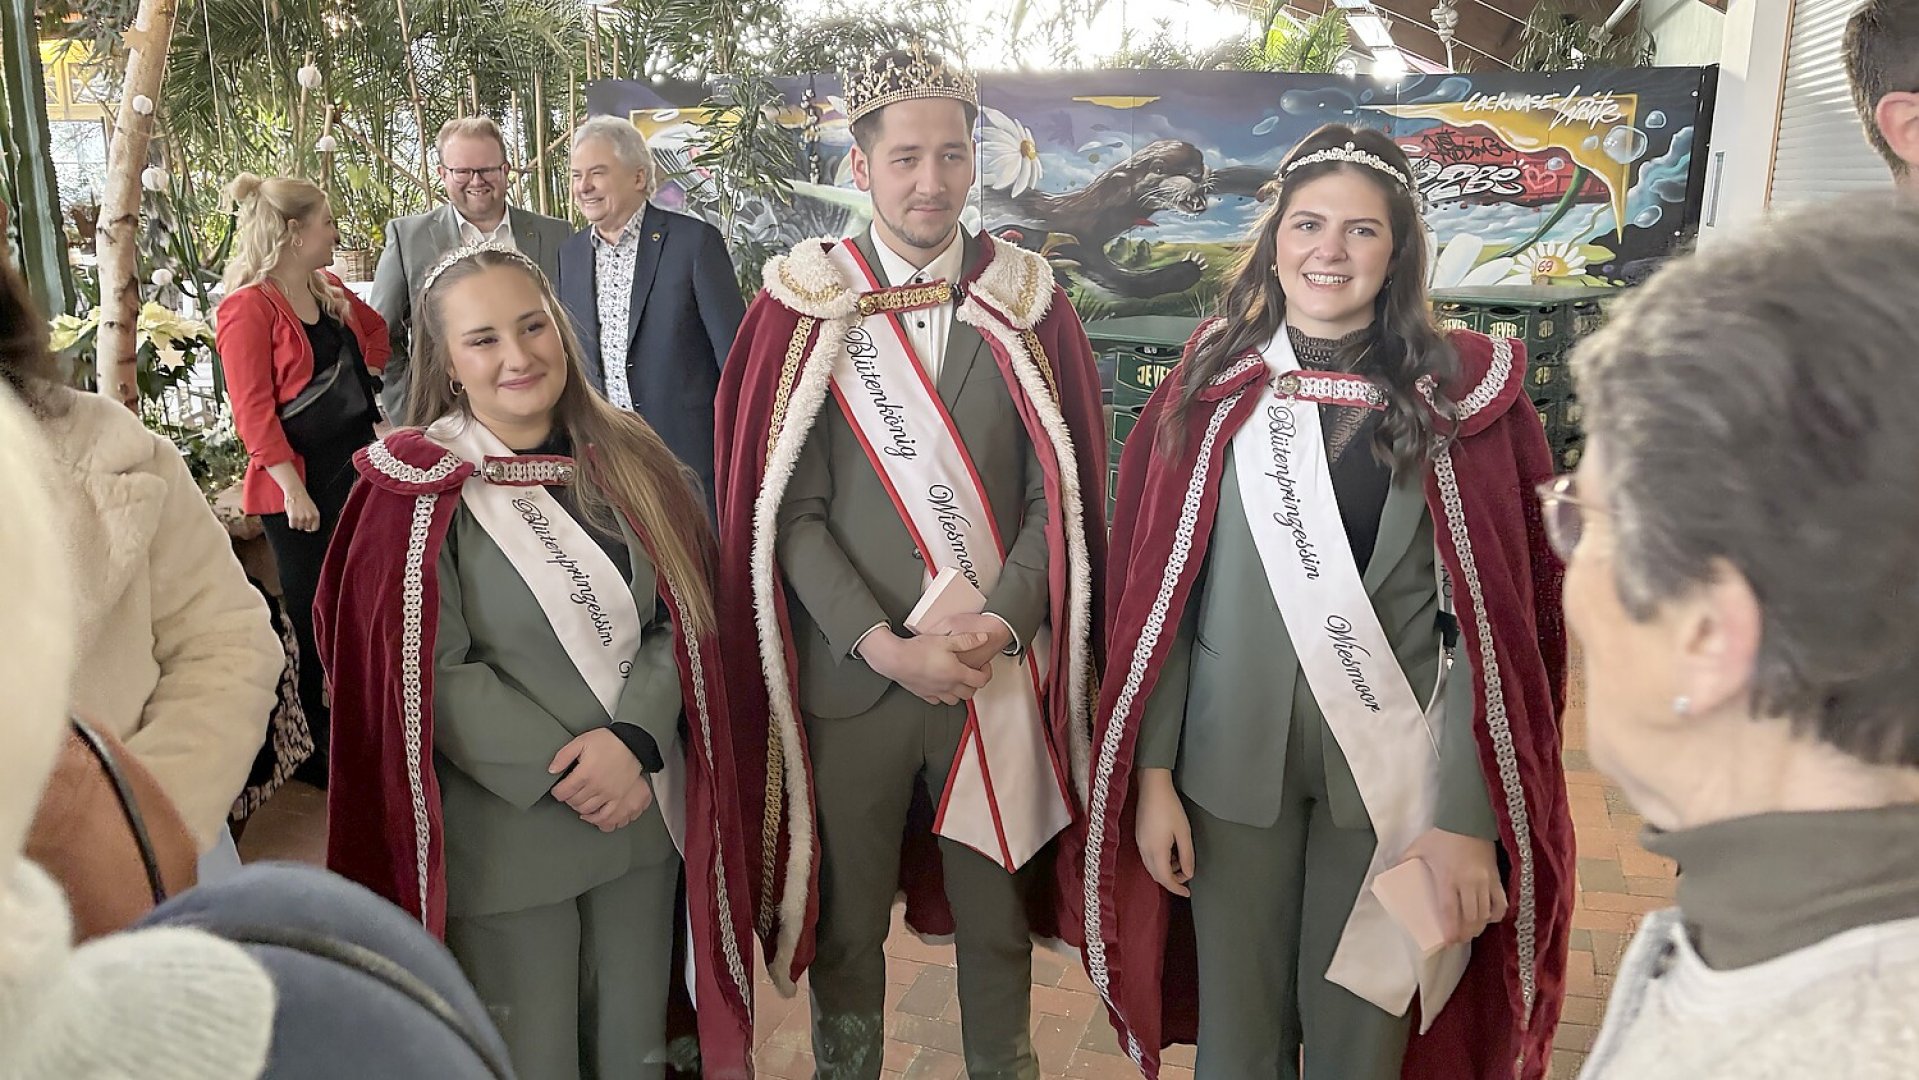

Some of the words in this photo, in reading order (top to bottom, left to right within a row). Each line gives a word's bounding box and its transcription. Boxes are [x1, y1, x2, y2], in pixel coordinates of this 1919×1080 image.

[1537, 259, 1554, 272] 69
[1137, 364, 1172, 388] JEVE
[846, 326, 918, 460] Blütenkönig
[927, 484, 980, 589] Wiesmoor
[512, 498, 613, 647] Blütenprinzessin
[1265, 405, 1320, 580] Blütenprinzessin
[1324, 615, 1380, 712] Wiesmoor
